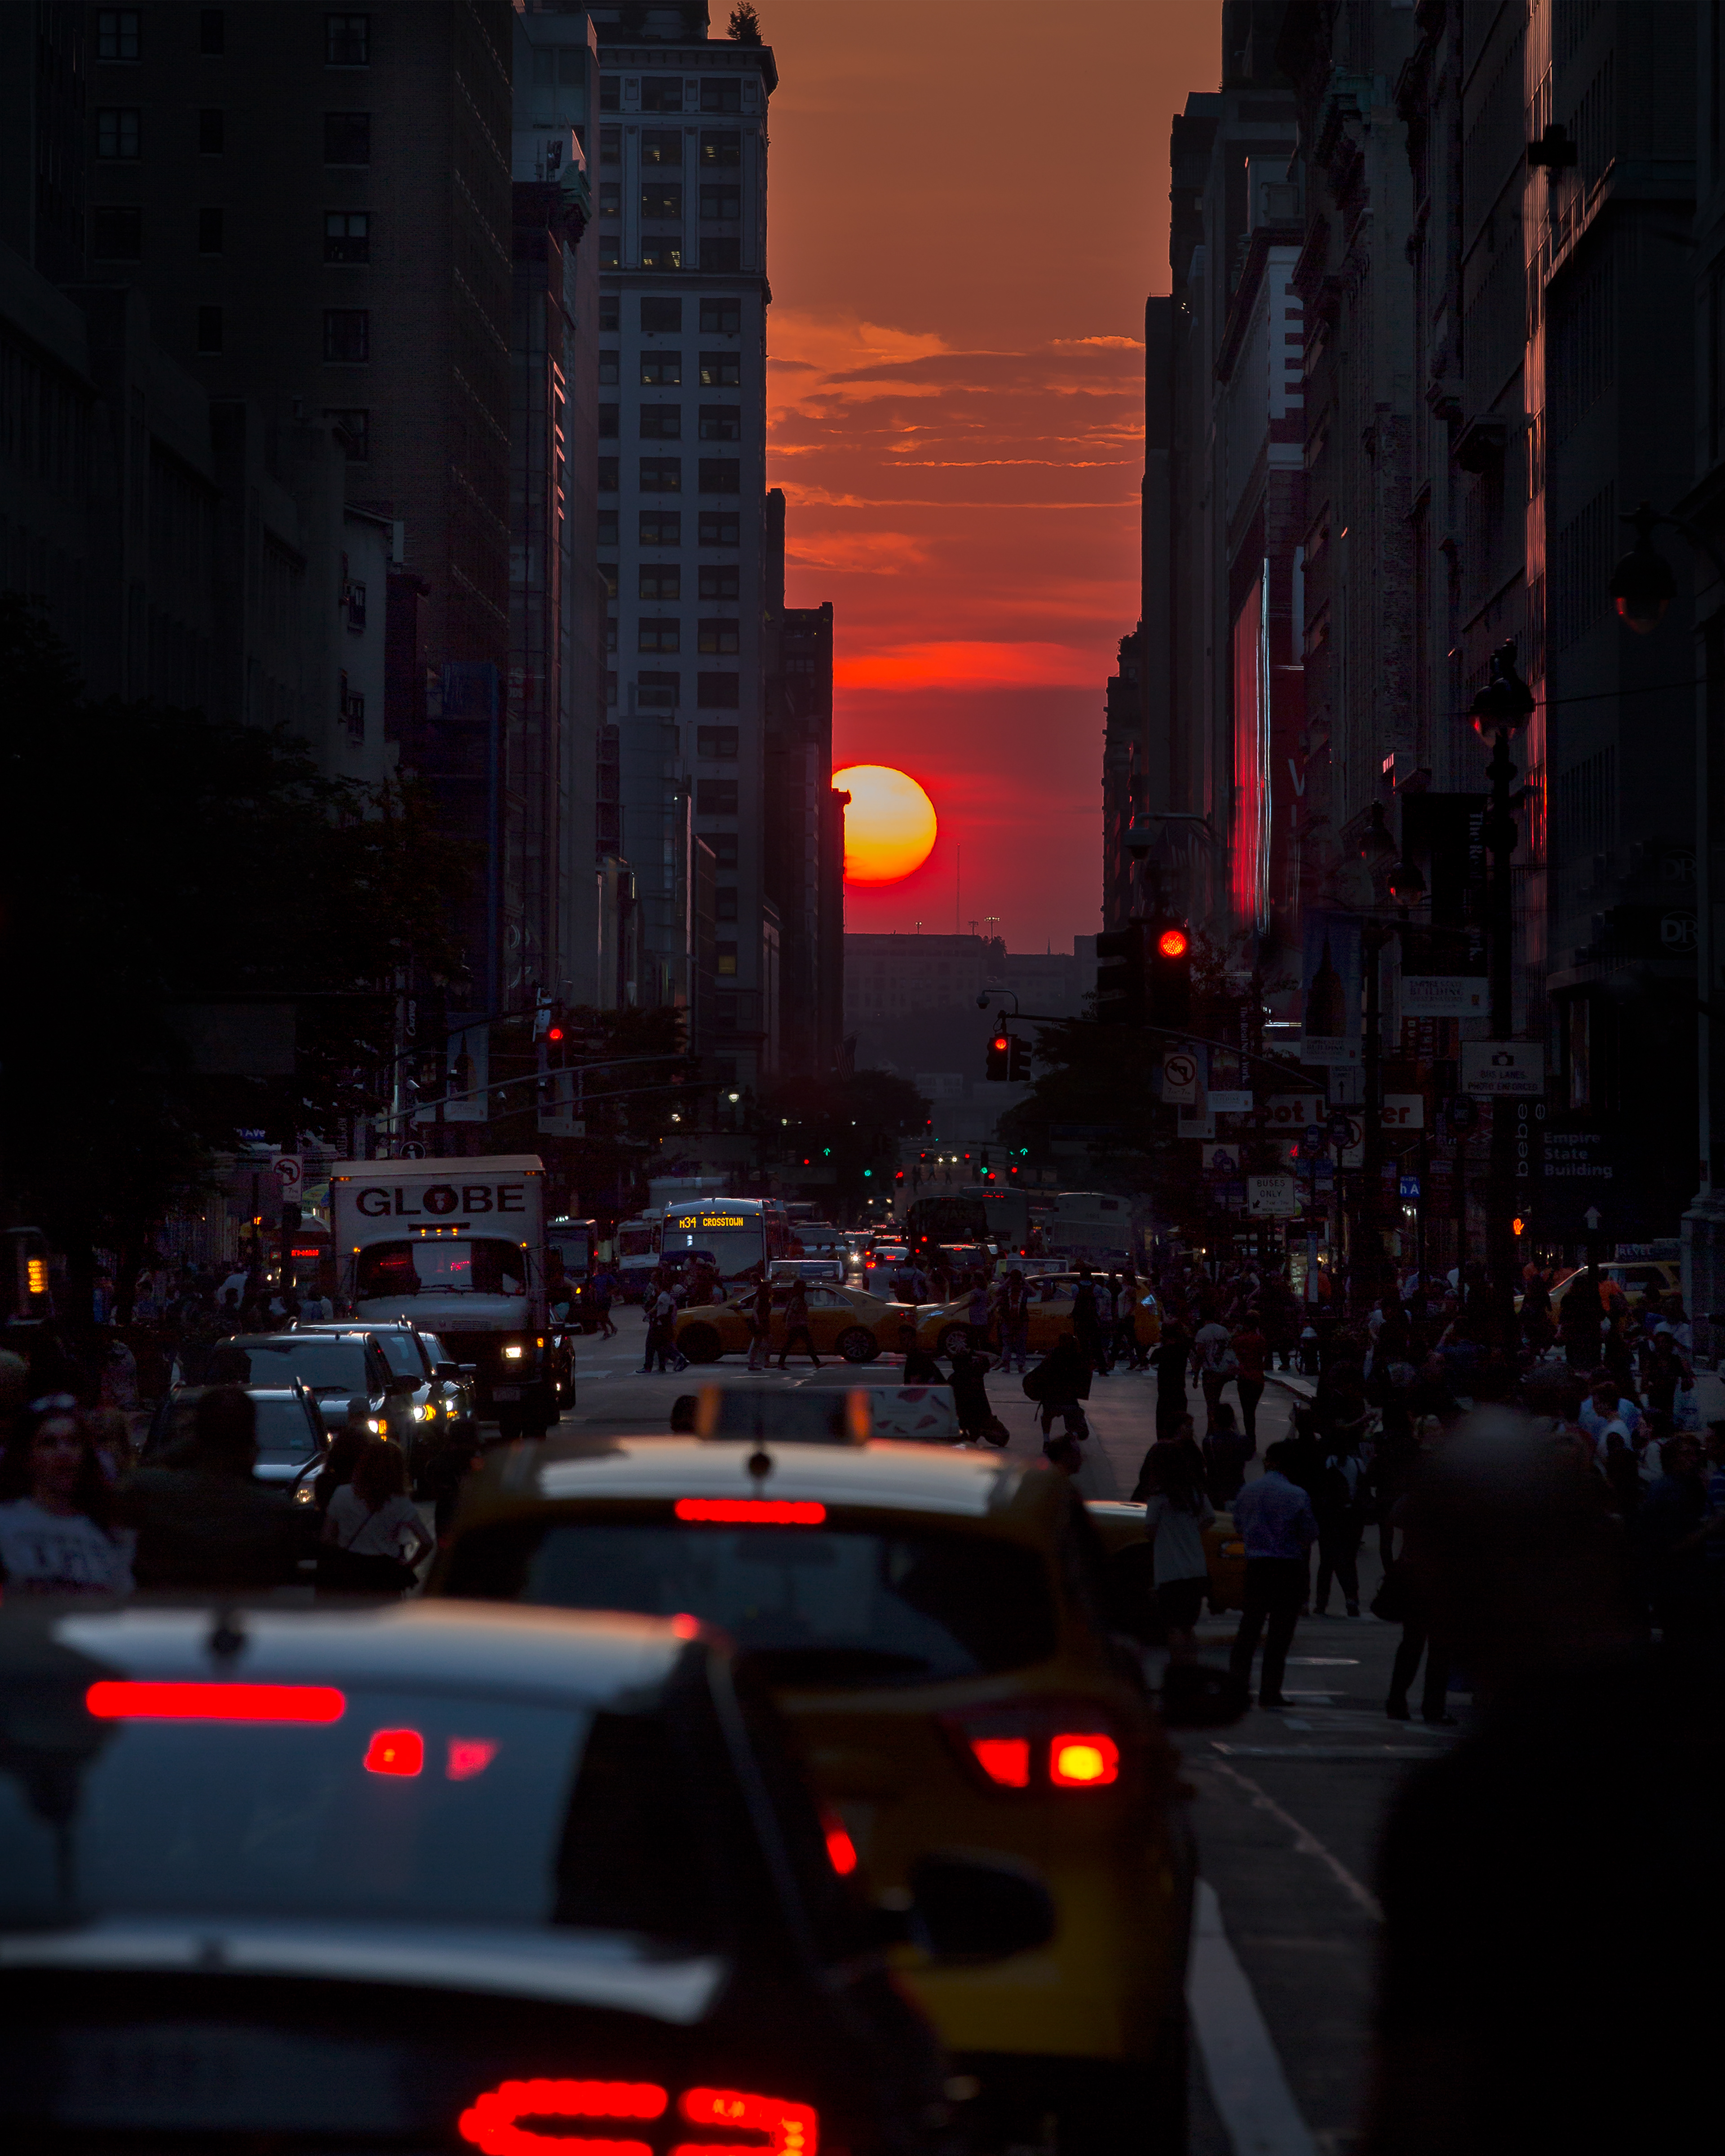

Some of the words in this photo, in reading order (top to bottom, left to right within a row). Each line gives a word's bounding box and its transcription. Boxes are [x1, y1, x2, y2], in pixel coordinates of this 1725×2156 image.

[1240, 1023, 1249, 1041] Real
[1515, 1103, 1528, 1177] bebe
[1544, 1131, 1601, 1146] Empire
[1544, 1148, 1588, 1160] State
[1544, 1163, 1613, 1179] Building
[356, 1184, 526, 1216] GLOBE
[679, 1217, 696, 1228] M34
[703, 1217, 743, 1226] CROSSTOWN
